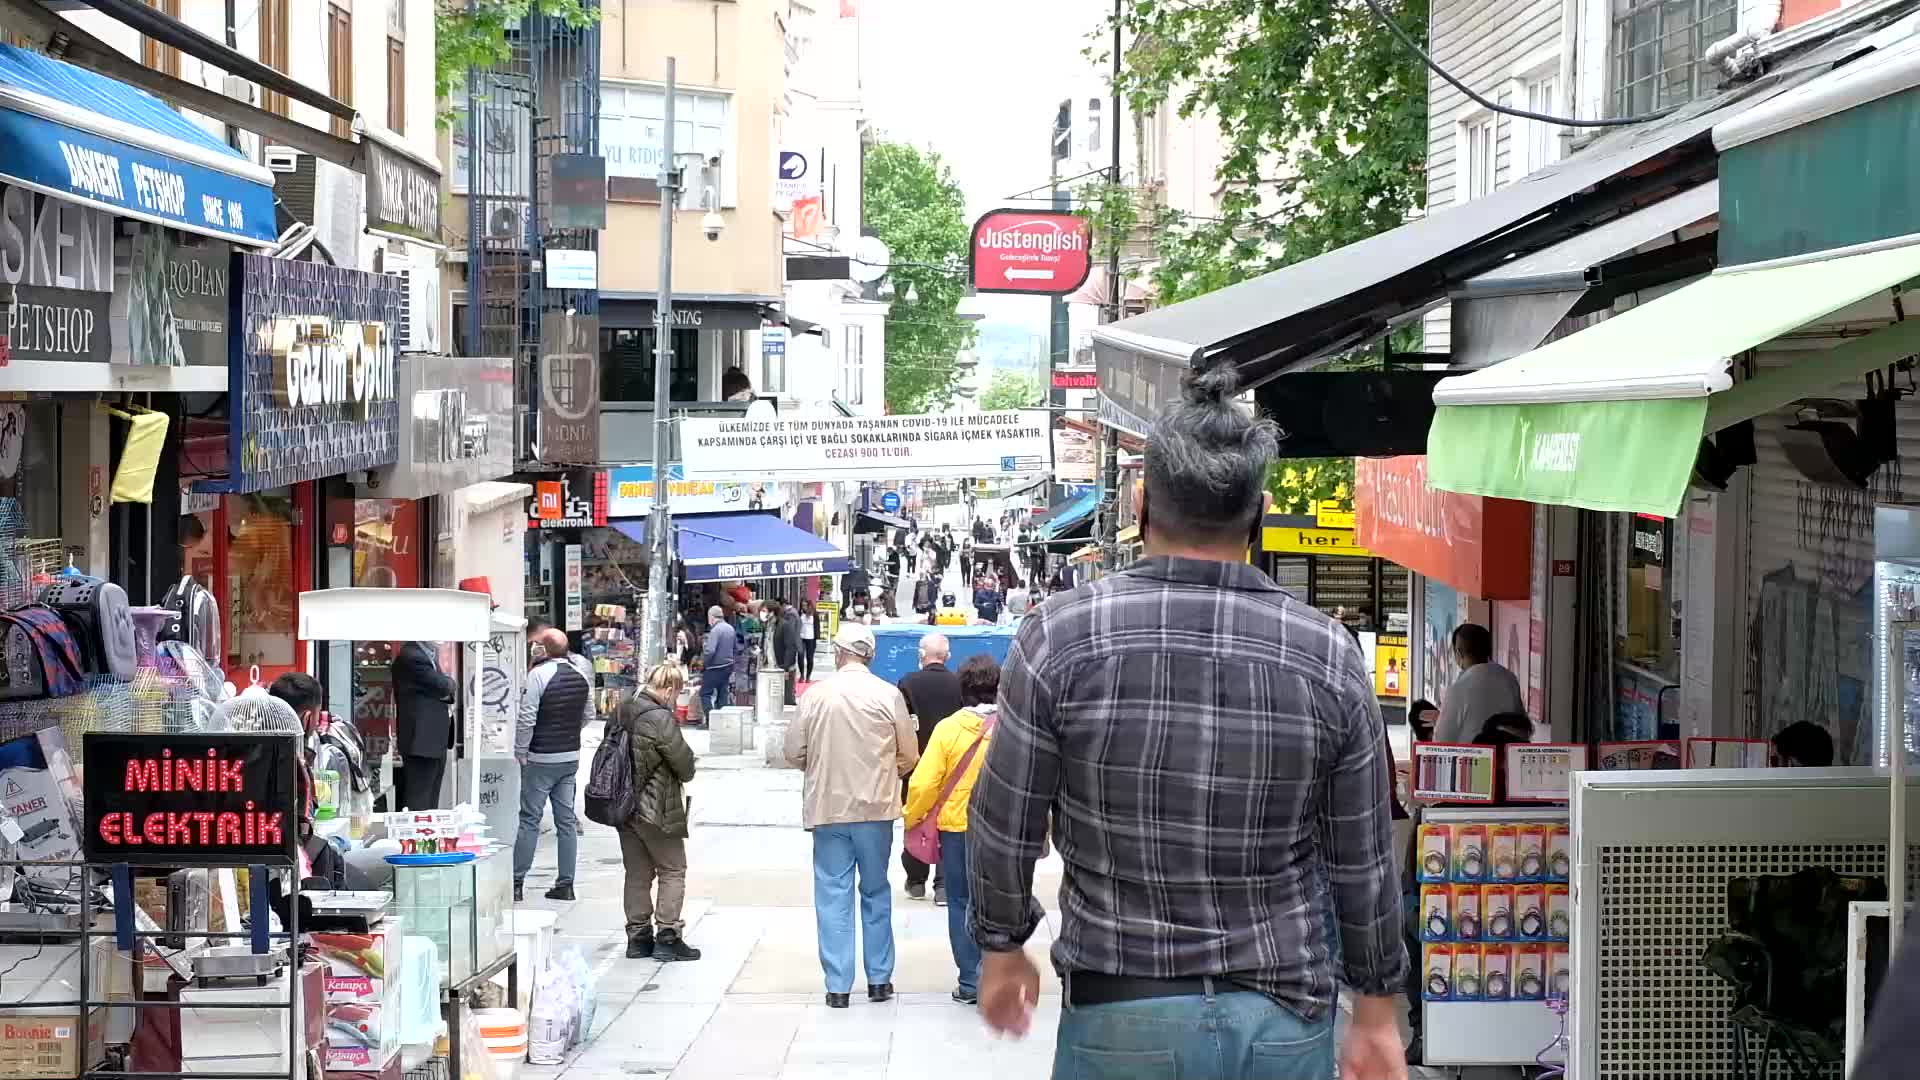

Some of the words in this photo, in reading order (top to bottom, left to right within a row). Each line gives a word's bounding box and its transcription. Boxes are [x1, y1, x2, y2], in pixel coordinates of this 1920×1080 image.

[132, 162, 186, 216] PETSHOP
[202, 194, 224, 227] SINCE
[980, 228, 1082, 253] Justenglish
[652, 309, 701, 325] NTAG
[8, 303, 93, 354] PETSHOP
[719, 420, 770, 433] ÜLKEMİZDE
[774, 421, 785, 432] VE
[789, 420, 808, 431] TÜM
[811, 420, 854, 431] DÜNYADA
[857, 419, 898, 431] YAŞANAN
[902, 417, 947, 428] COVID-19
[950, 416, 964, 427] İLE
[968, 414, 1019, 425] MÜCADELE
[698, 435, 757, 447] KAPSAMINDA
[806, 434, 818, 445] VE
[821, 432, 848, 444] BAĞLI
[851, 432, 921, 444] SOKAKLARINDA
[924, 429, 959, 442] SİGARA
[961, 429, 992, 443] İÇMEK
[995, 427, 1044, 439] YASAKTIR.
[825, 448, 858, 459] CEZASI
[860, 448, 878, 458] 900
[540, 516, 593, 528] elektronik
[1299, 532, 1340, 545] her
[718, 560, 763, 577] HEDİYELİK
[771, 562, 778, 574] &
[784, 560, 824, 573] OYUNCAK
[125, 748, 245, 792] MİNİK
[11, 797, 46, 815] TANER
[100, 800, 282, 845] ELEKTRİK
